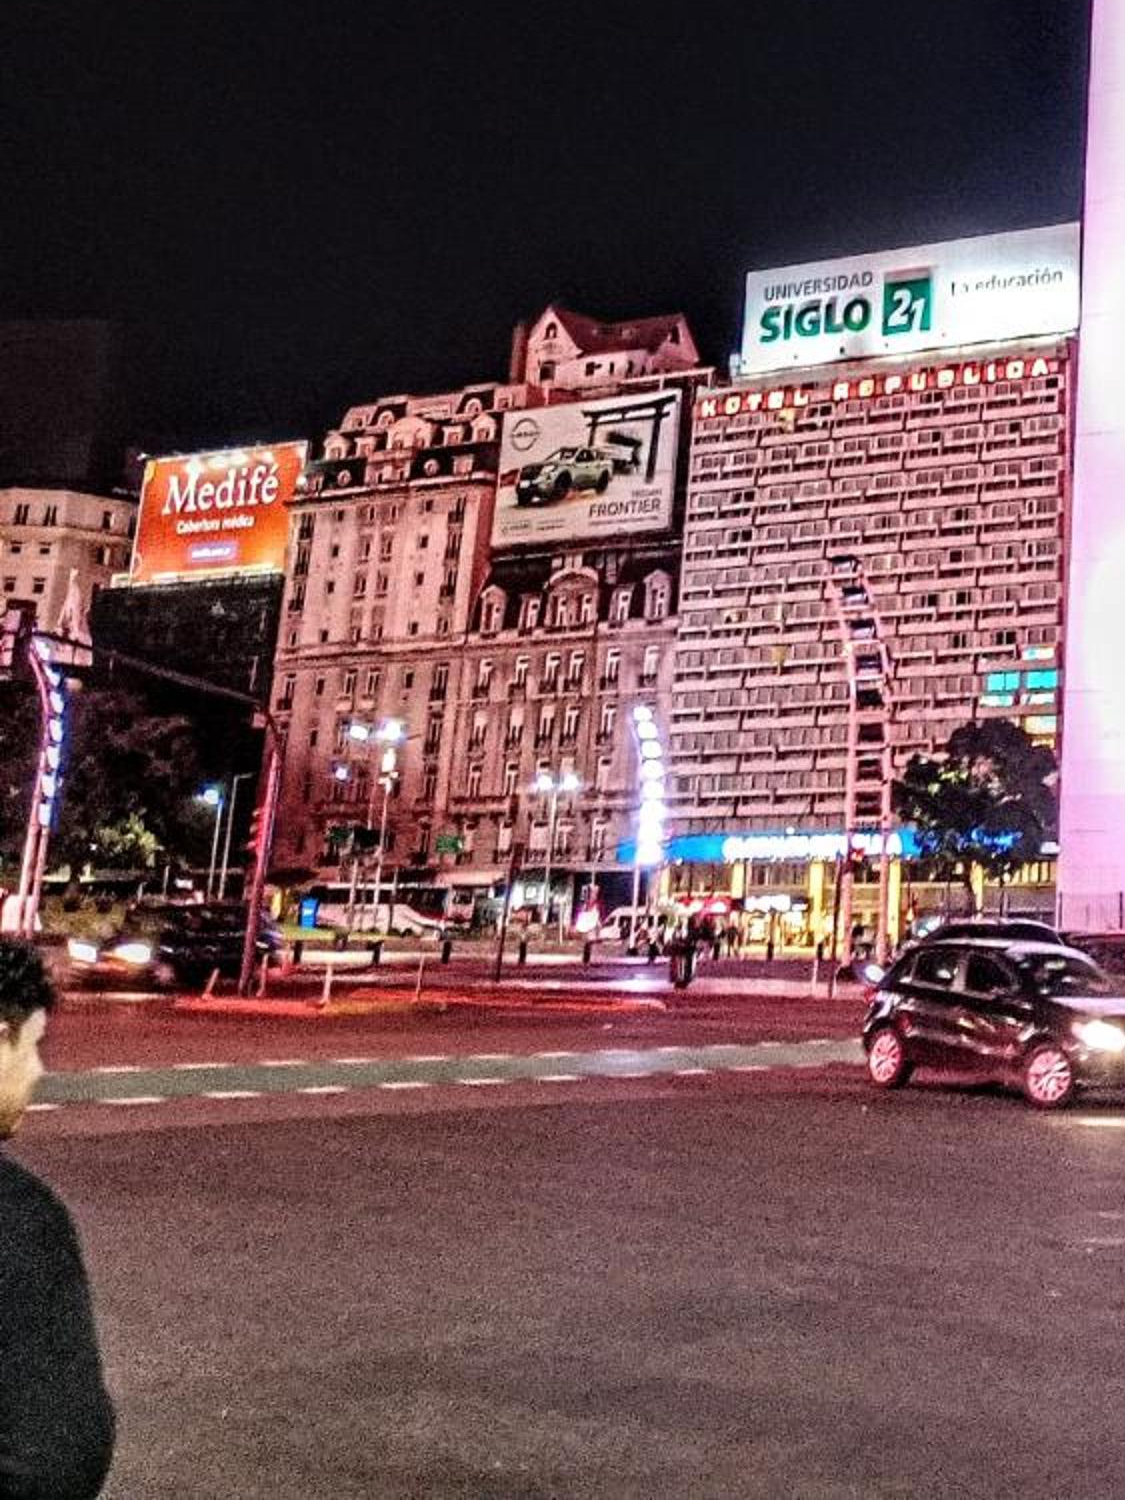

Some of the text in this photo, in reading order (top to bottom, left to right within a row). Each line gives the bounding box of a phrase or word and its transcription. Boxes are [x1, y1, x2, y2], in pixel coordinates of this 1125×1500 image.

[763, 270, 874, 301] UNIVERSIDAD
[760, 287, 930, 344] SIGLO 21
[161, 463, 280, 516] Medifé
[589, 497, 662, 518] FRONTIER
